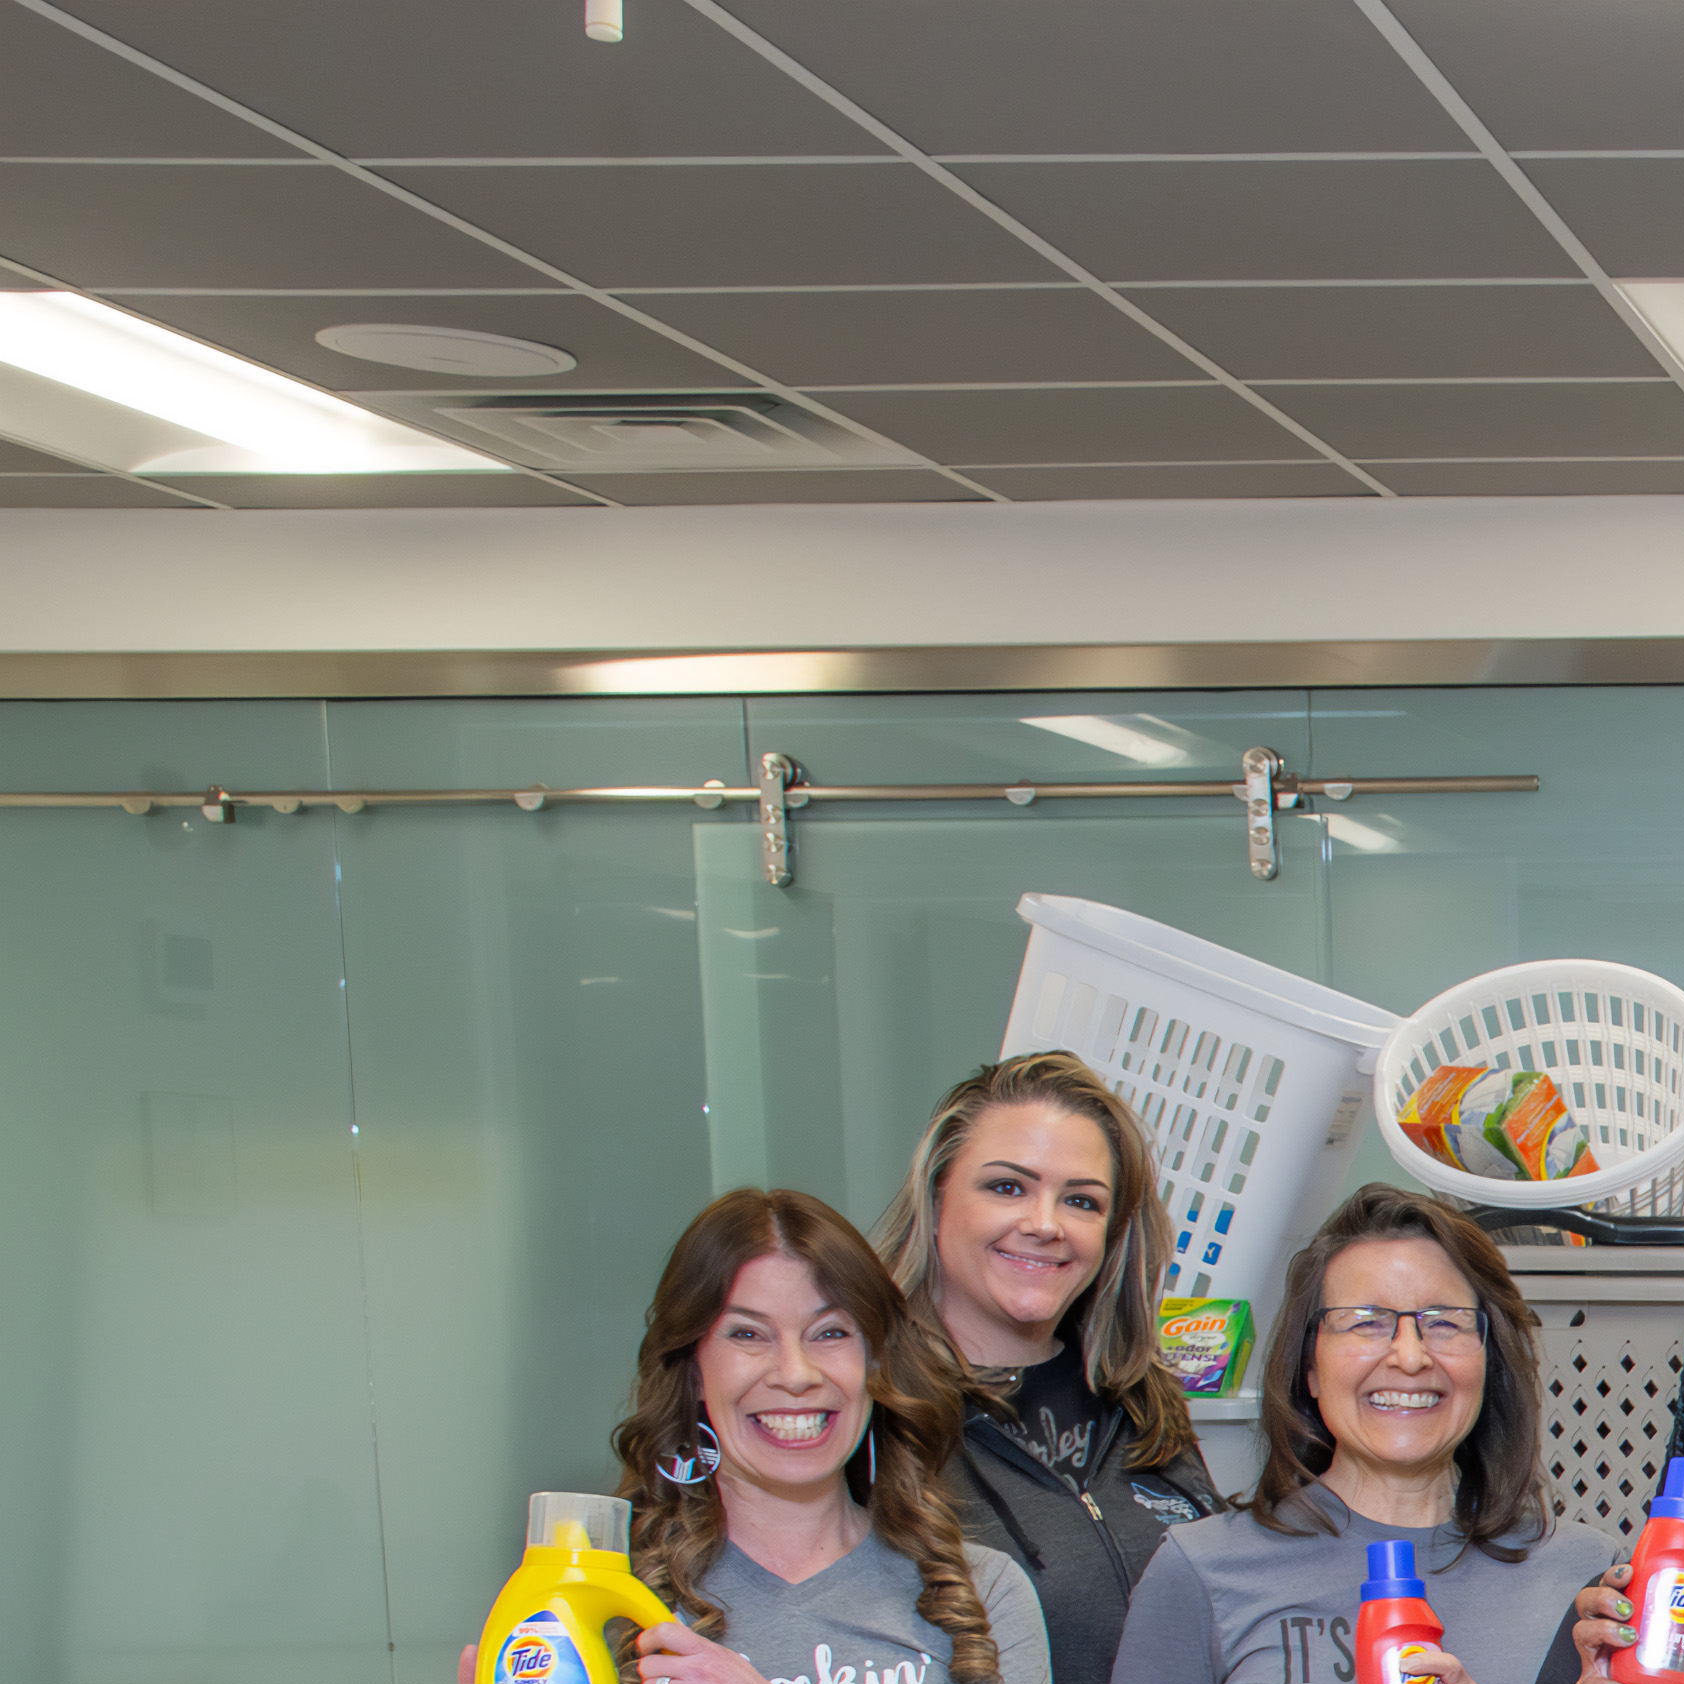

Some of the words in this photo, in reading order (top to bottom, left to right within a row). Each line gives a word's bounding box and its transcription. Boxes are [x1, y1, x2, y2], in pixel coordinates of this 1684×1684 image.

[1164, 1317, 1226, 1336] Gain
[511, 1648, 552, 1676] Tide
[1280, 1617, 1355, 1684] IT'S
